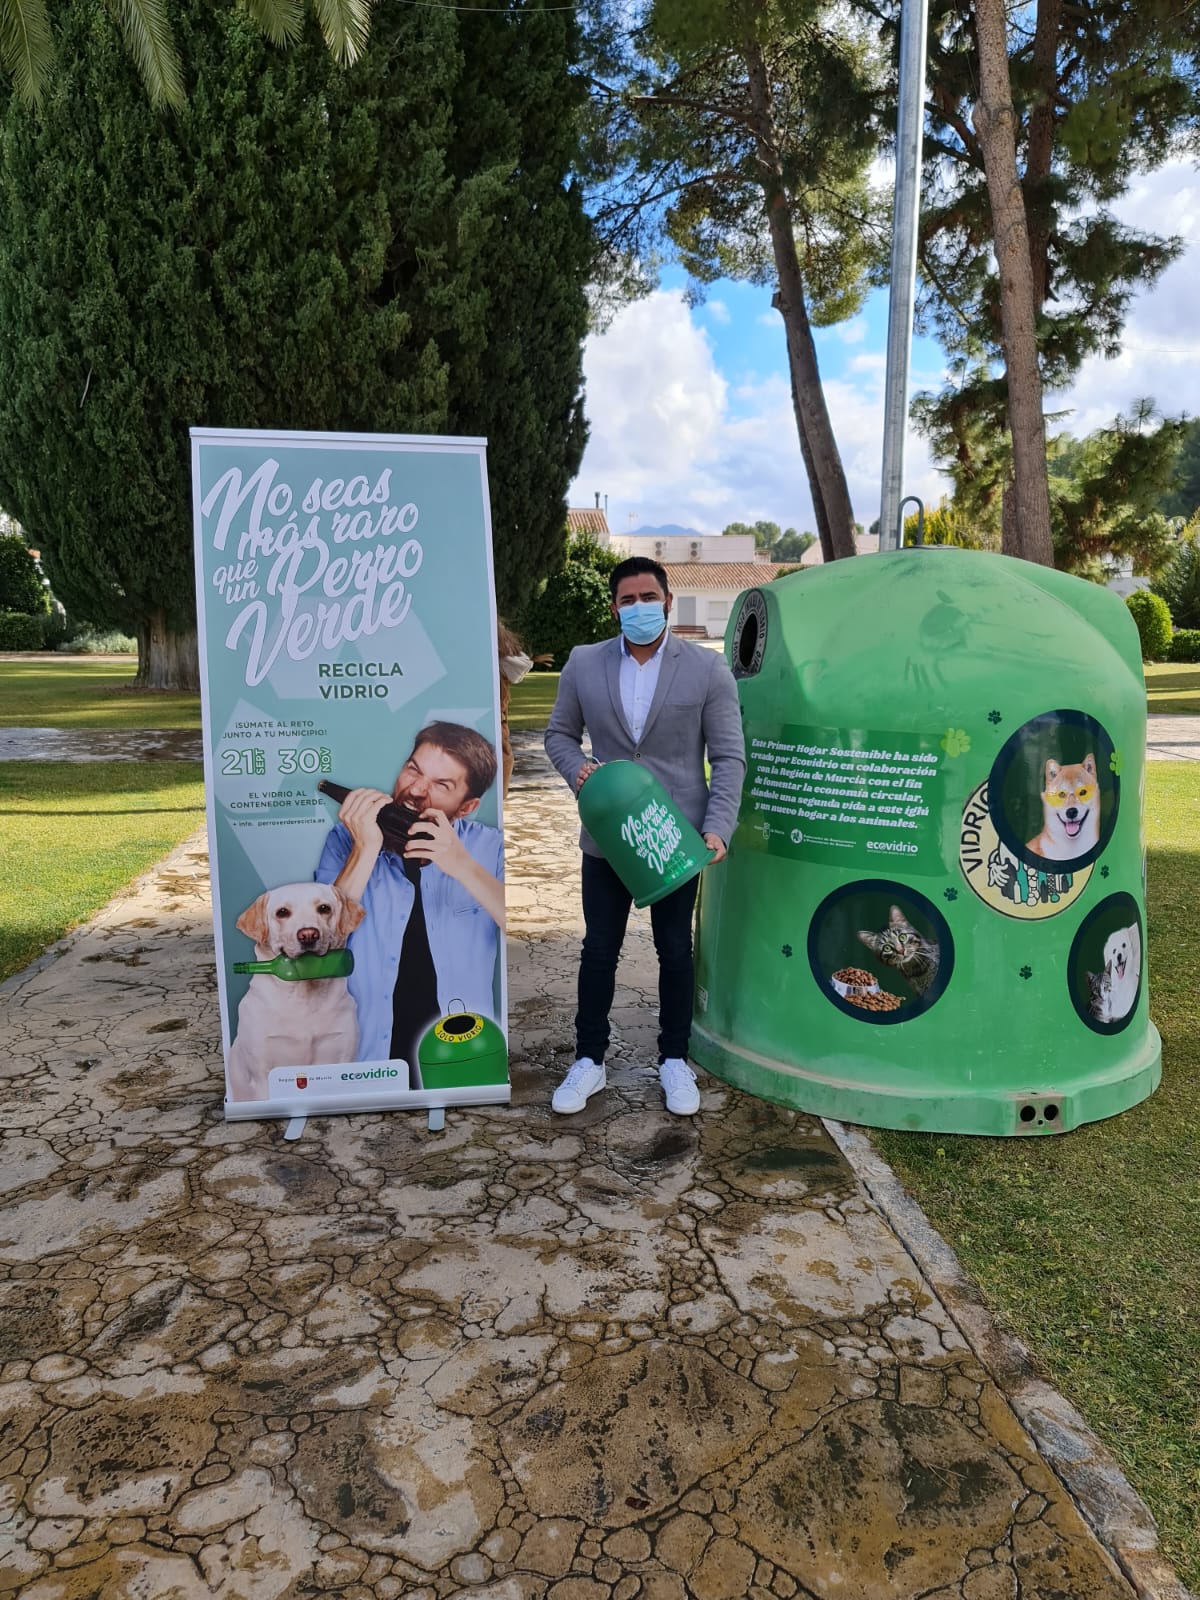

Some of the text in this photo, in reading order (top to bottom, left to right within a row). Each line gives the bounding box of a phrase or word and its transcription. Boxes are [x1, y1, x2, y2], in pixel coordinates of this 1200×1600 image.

[201, 457, 393, 551] No seas
[237, 502, 418, 560] más raro
[212, 538, 423, 604] que un Perro
[224, 572, 412, 687] Verde
[318, 662, 404, 678] RECICLA
[319, 684, 389, 699] VIDRIO
[222, 729, 327, 739] JUNTO A TU MUNICIPIO!
[276, 720, 288, 728] AL
[290, 720, 314, 728] RETO
[221, 746, 332, 775] 21 SEPT 30 NOV
[752, 738, 938, 763] Este Primer Hogar Sostenible ha sido
[751, 752, 937, 776] creado por Ecovidrio en colaboración
[757, 765, 923, 789] con la Región de Murcia con el fin
[262, 790, 293, 798] VIDRIO
[751, 787, 930, 817] dándole una segunda vida a este iglú
[754, 776, 924, 804] de fomentar la economía circular,
[230, 800, 292, 809] CONTENEDOR
[754, 802, 760, 810] y
[760, 802, 770, 811] un
[771, 805, 797, 815] nuevo
[797, 807, 829, 820] hogar
[838, 813, 857, 823] los
[858, 816, 918, 829] animales.
[866, 840, 919, 853] ecovidrio
[457, 1025, 482, 1041] VIDRIO
[341, 1067, 398, 1081] ecovidrio
